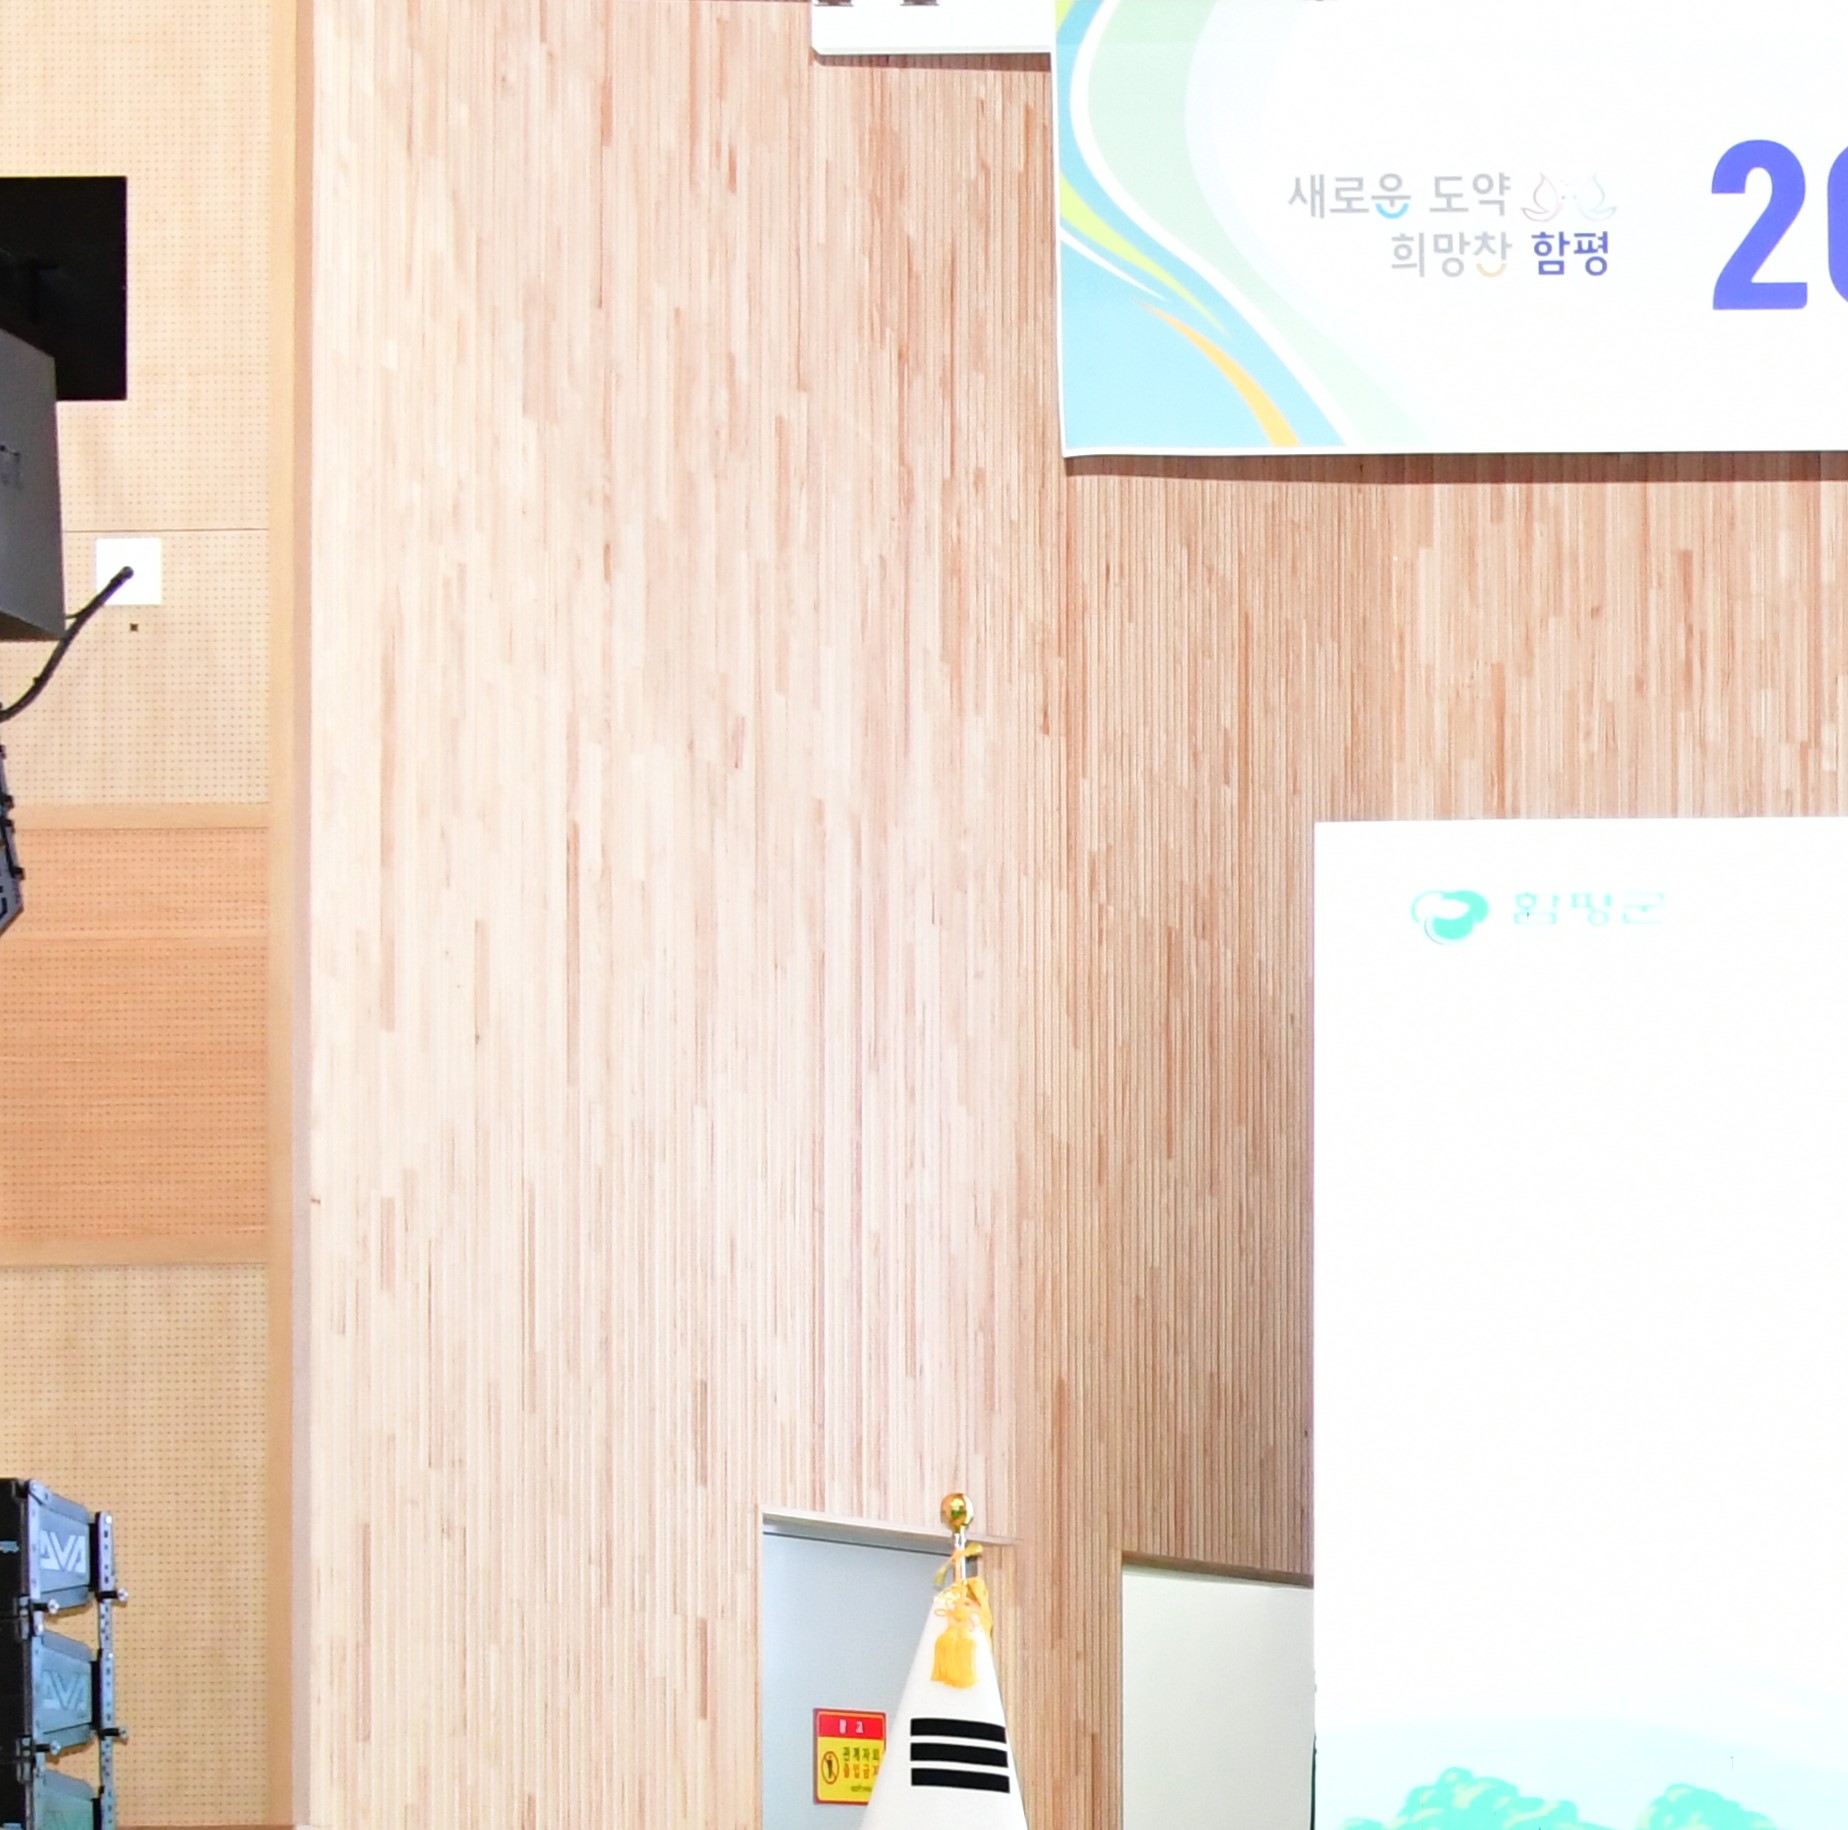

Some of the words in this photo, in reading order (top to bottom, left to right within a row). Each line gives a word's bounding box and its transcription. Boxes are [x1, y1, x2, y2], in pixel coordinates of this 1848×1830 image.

[1288, 172, 1412, 220] 새로운
[1429, 172, 1512, 217] 도약
[1391, 231, 1513, 278] 희망찬
[1531, 231, 1609, 277] 함평
